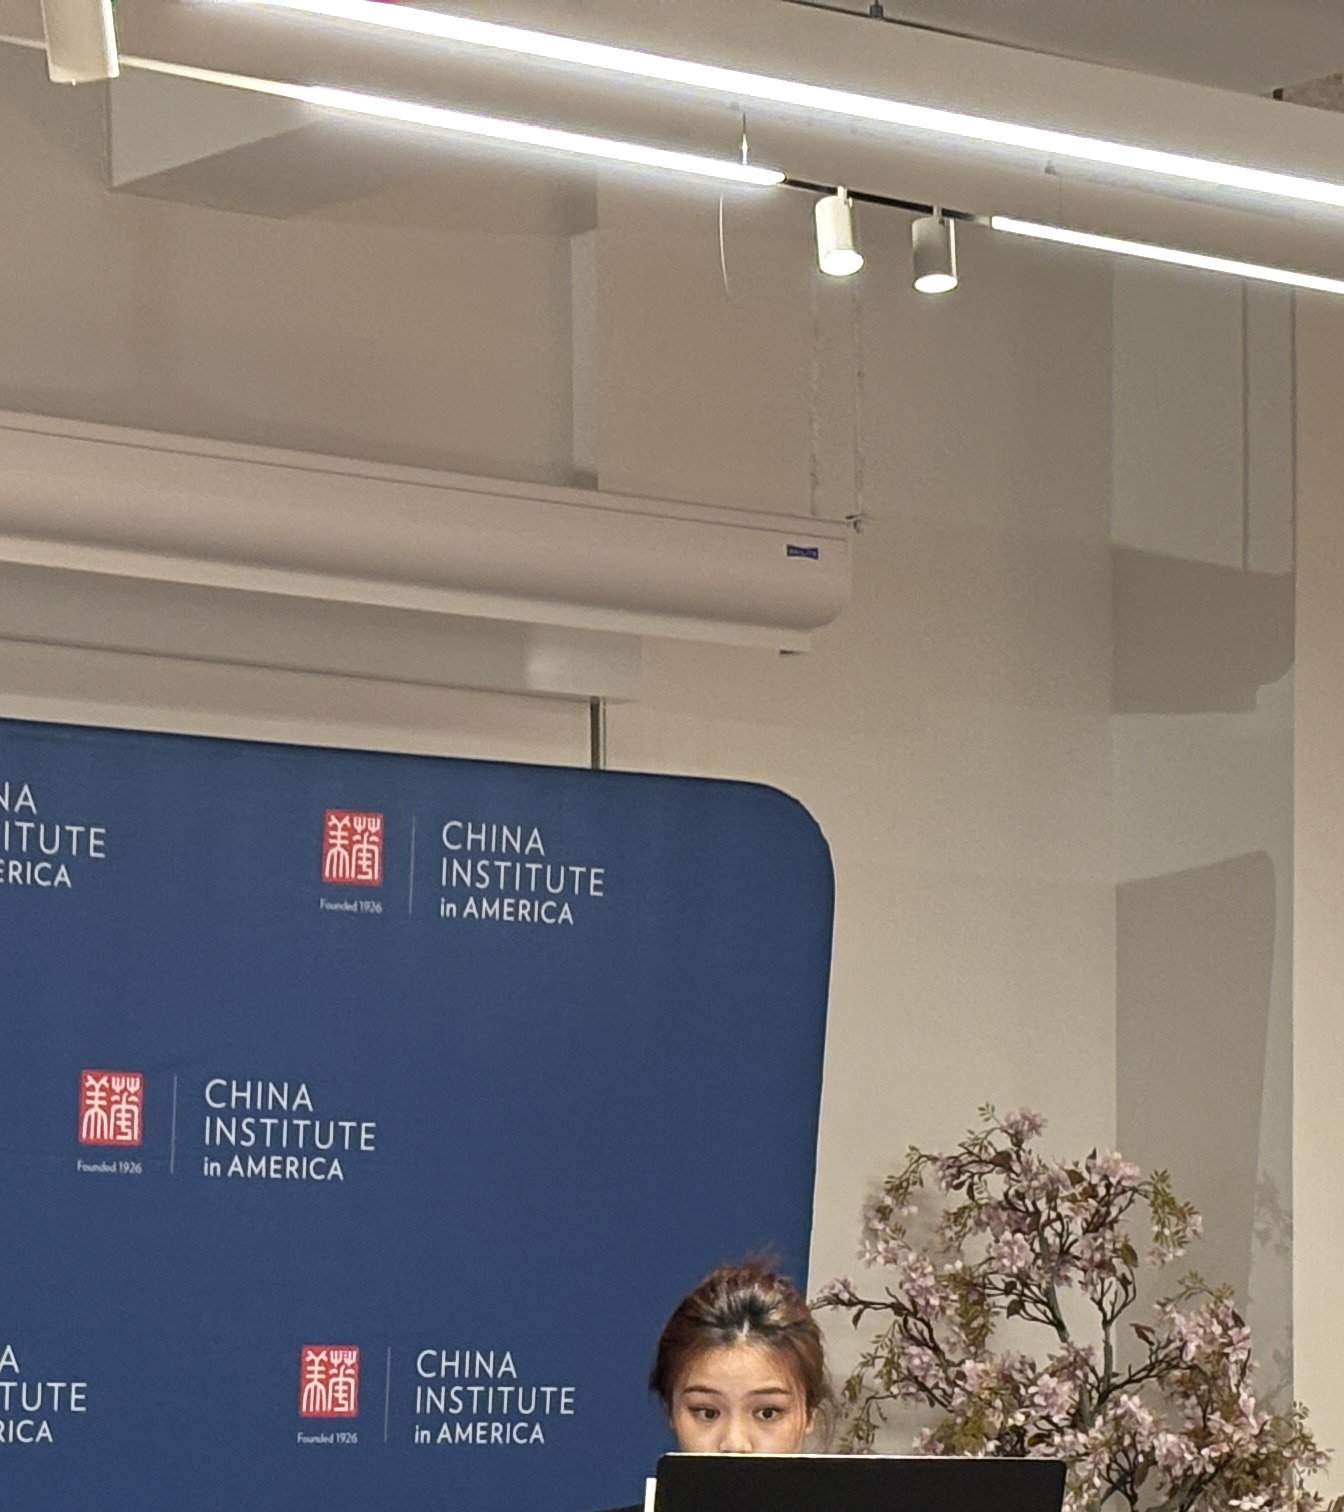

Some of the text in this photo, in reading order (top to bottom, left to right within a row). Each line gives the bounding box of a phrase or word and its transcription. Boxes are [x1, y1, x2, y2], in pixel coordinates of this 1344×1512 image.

[442, 820, 545, 856] CHINA
[441, 857, 605, 897] INSTITUTE
[440, 896, 574, 925] in AMERICA
[205, 1078, 314, 1112] CHINA
[204, 1115, 376, 1151] INSTITUTE
[77, 1158, 145, 1175] Founded 1926
[203, 1154, 344, 1181] in AMERICA
[416, 1349, 518, 1379] CHINA
[416, 1385, 576, 1415] INSTITUTE
[297, 1431, 360, 1445] Founded 1926
[414, 1421, 545, 1445] in AMERICA
